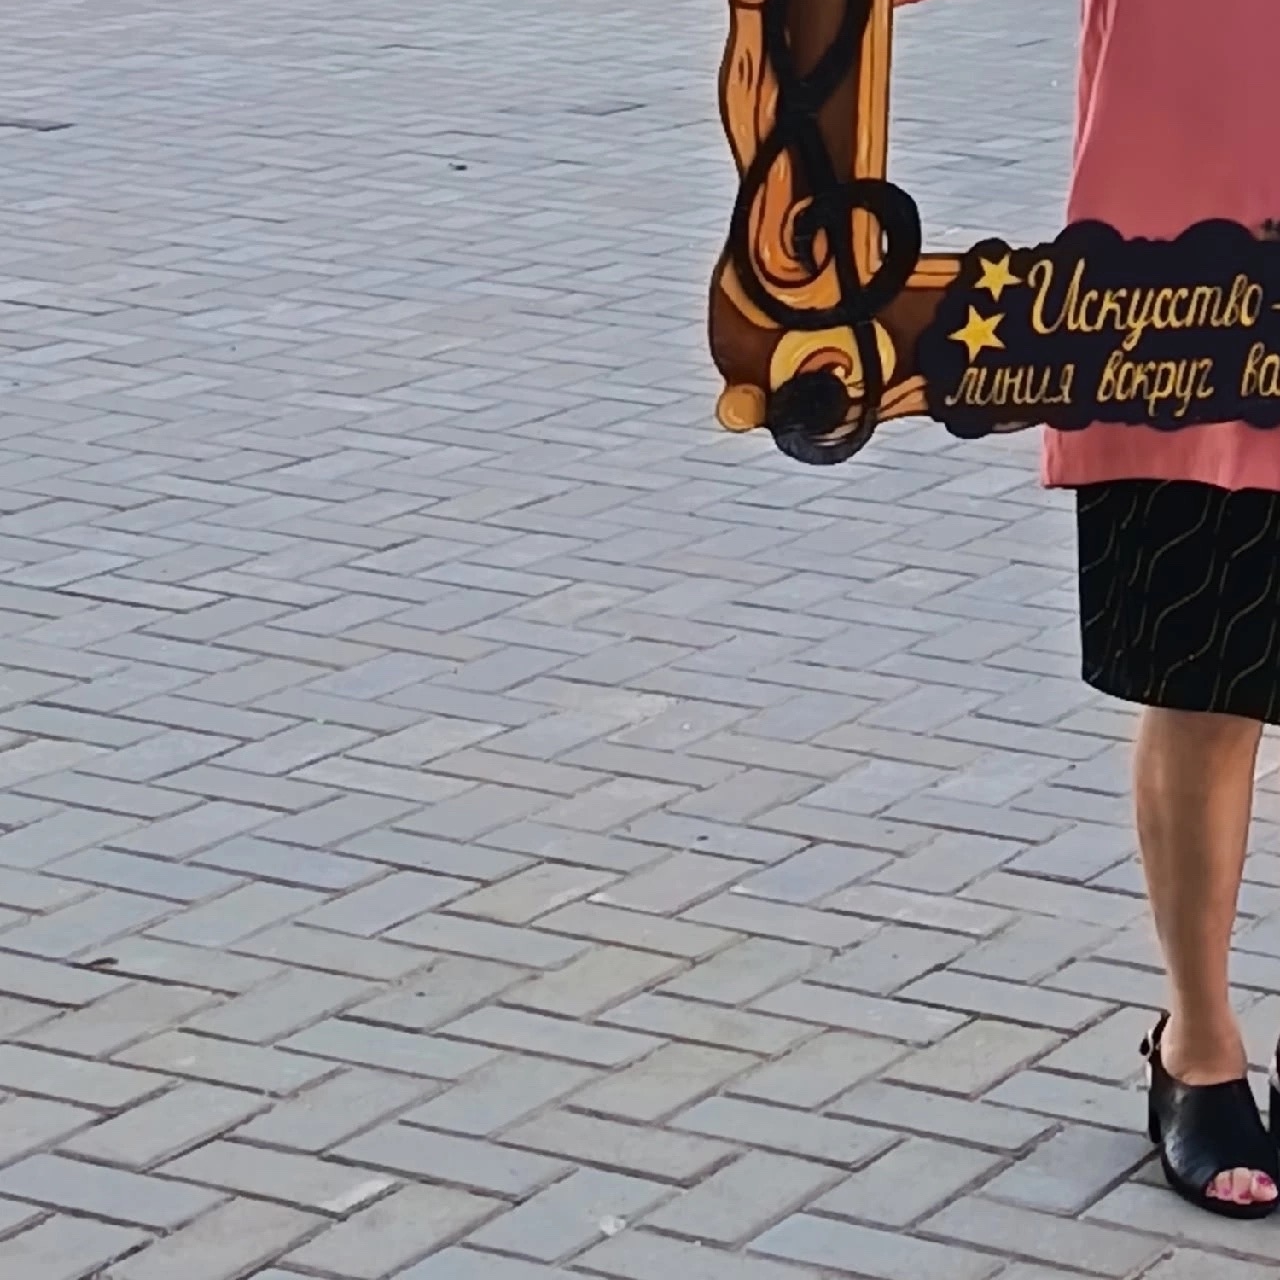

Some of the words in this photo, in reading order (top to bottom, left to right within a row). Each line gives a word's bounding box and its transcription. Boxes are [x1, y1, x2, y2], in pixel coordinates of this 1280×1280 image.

[1026, 257, 1264, 352] Искусство
[944, 363, 1076, 407] линия
[1095, 349, 1215, 418] вокруг
